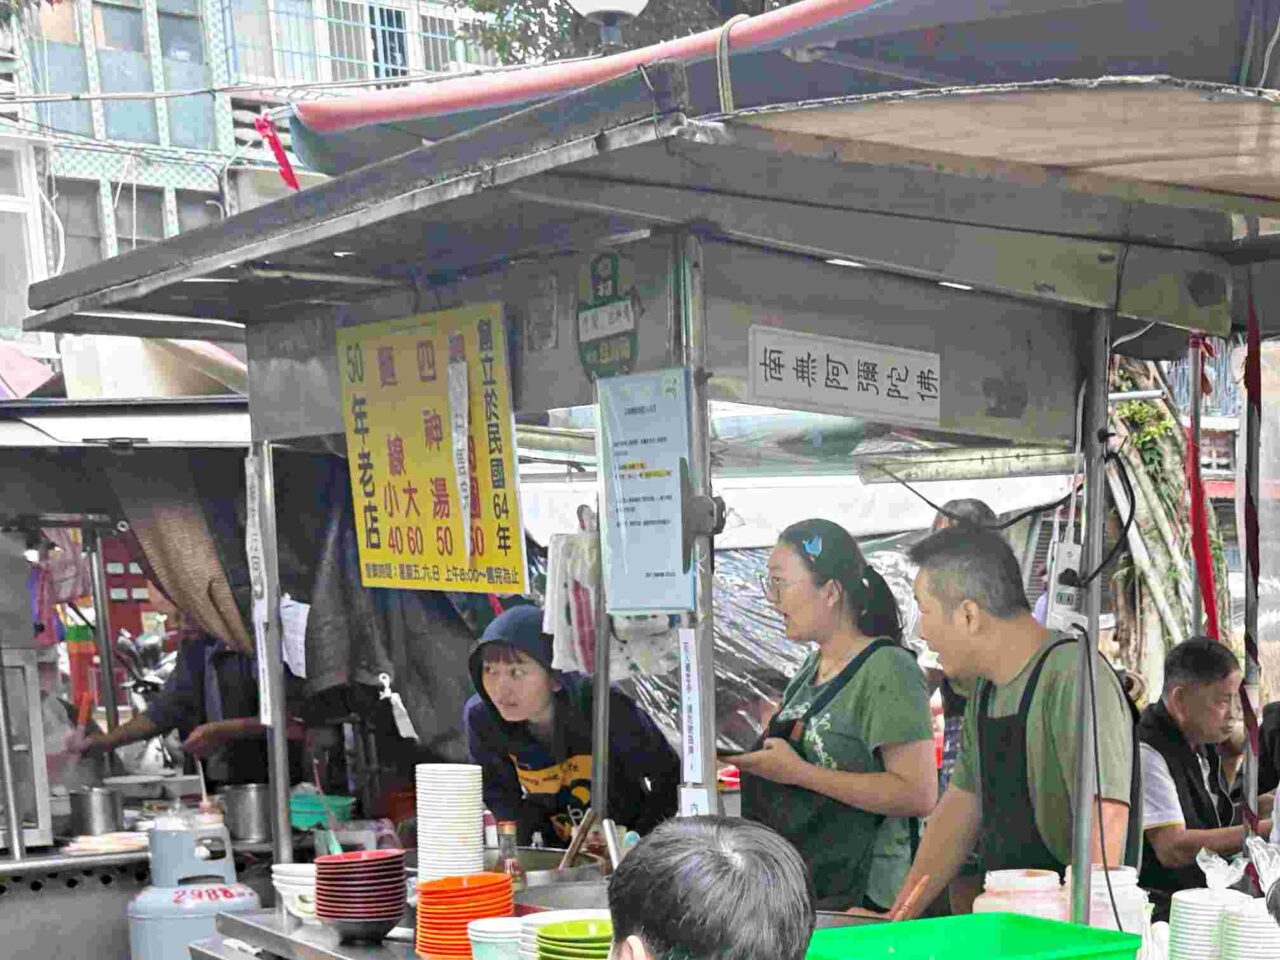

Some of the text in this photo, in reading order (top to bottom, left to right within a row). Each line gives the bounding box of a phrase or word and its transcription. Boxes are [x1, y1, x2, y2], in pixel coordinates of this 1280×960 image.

[759, 346, 940, 402] 南無阿彌陀佛
[416, 339, 451, 520] 四神湯
[383, 481, 400, 519] 小
[402, 480, 421, 519] 大
[387, 526, 424, 556] 40 60
[436, 526, 453, 557] 50
